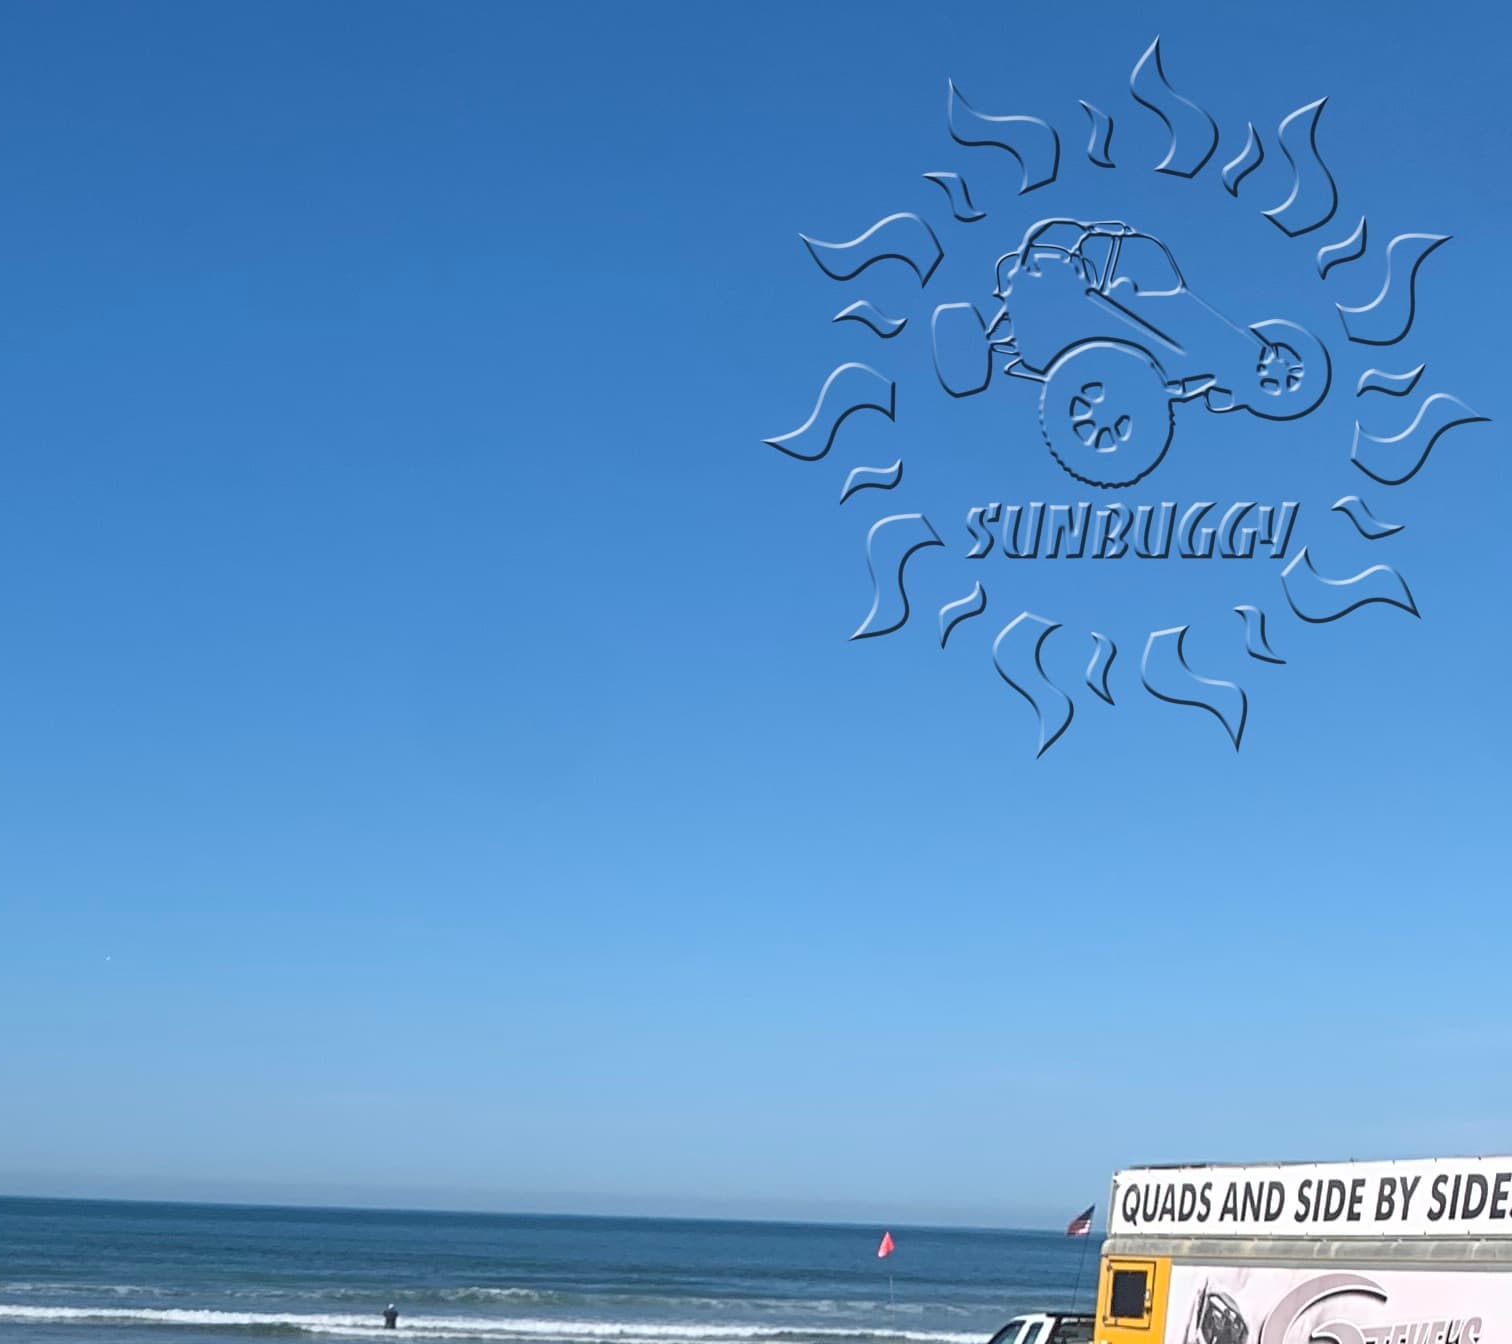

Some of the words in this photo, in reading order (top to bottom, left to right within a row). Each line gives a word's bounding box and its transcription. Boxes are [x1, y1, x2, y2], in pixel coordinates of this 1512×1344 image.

[1121, 1182, 1213, 1226] QUADS
[1218, 1180, 1286, 1222] AND
[1294, 1178, 1366, 1223] SIDE
[1374, 1175, 1422, 1221] BY
[1426, 1172, 1512, 1221] SIDE
